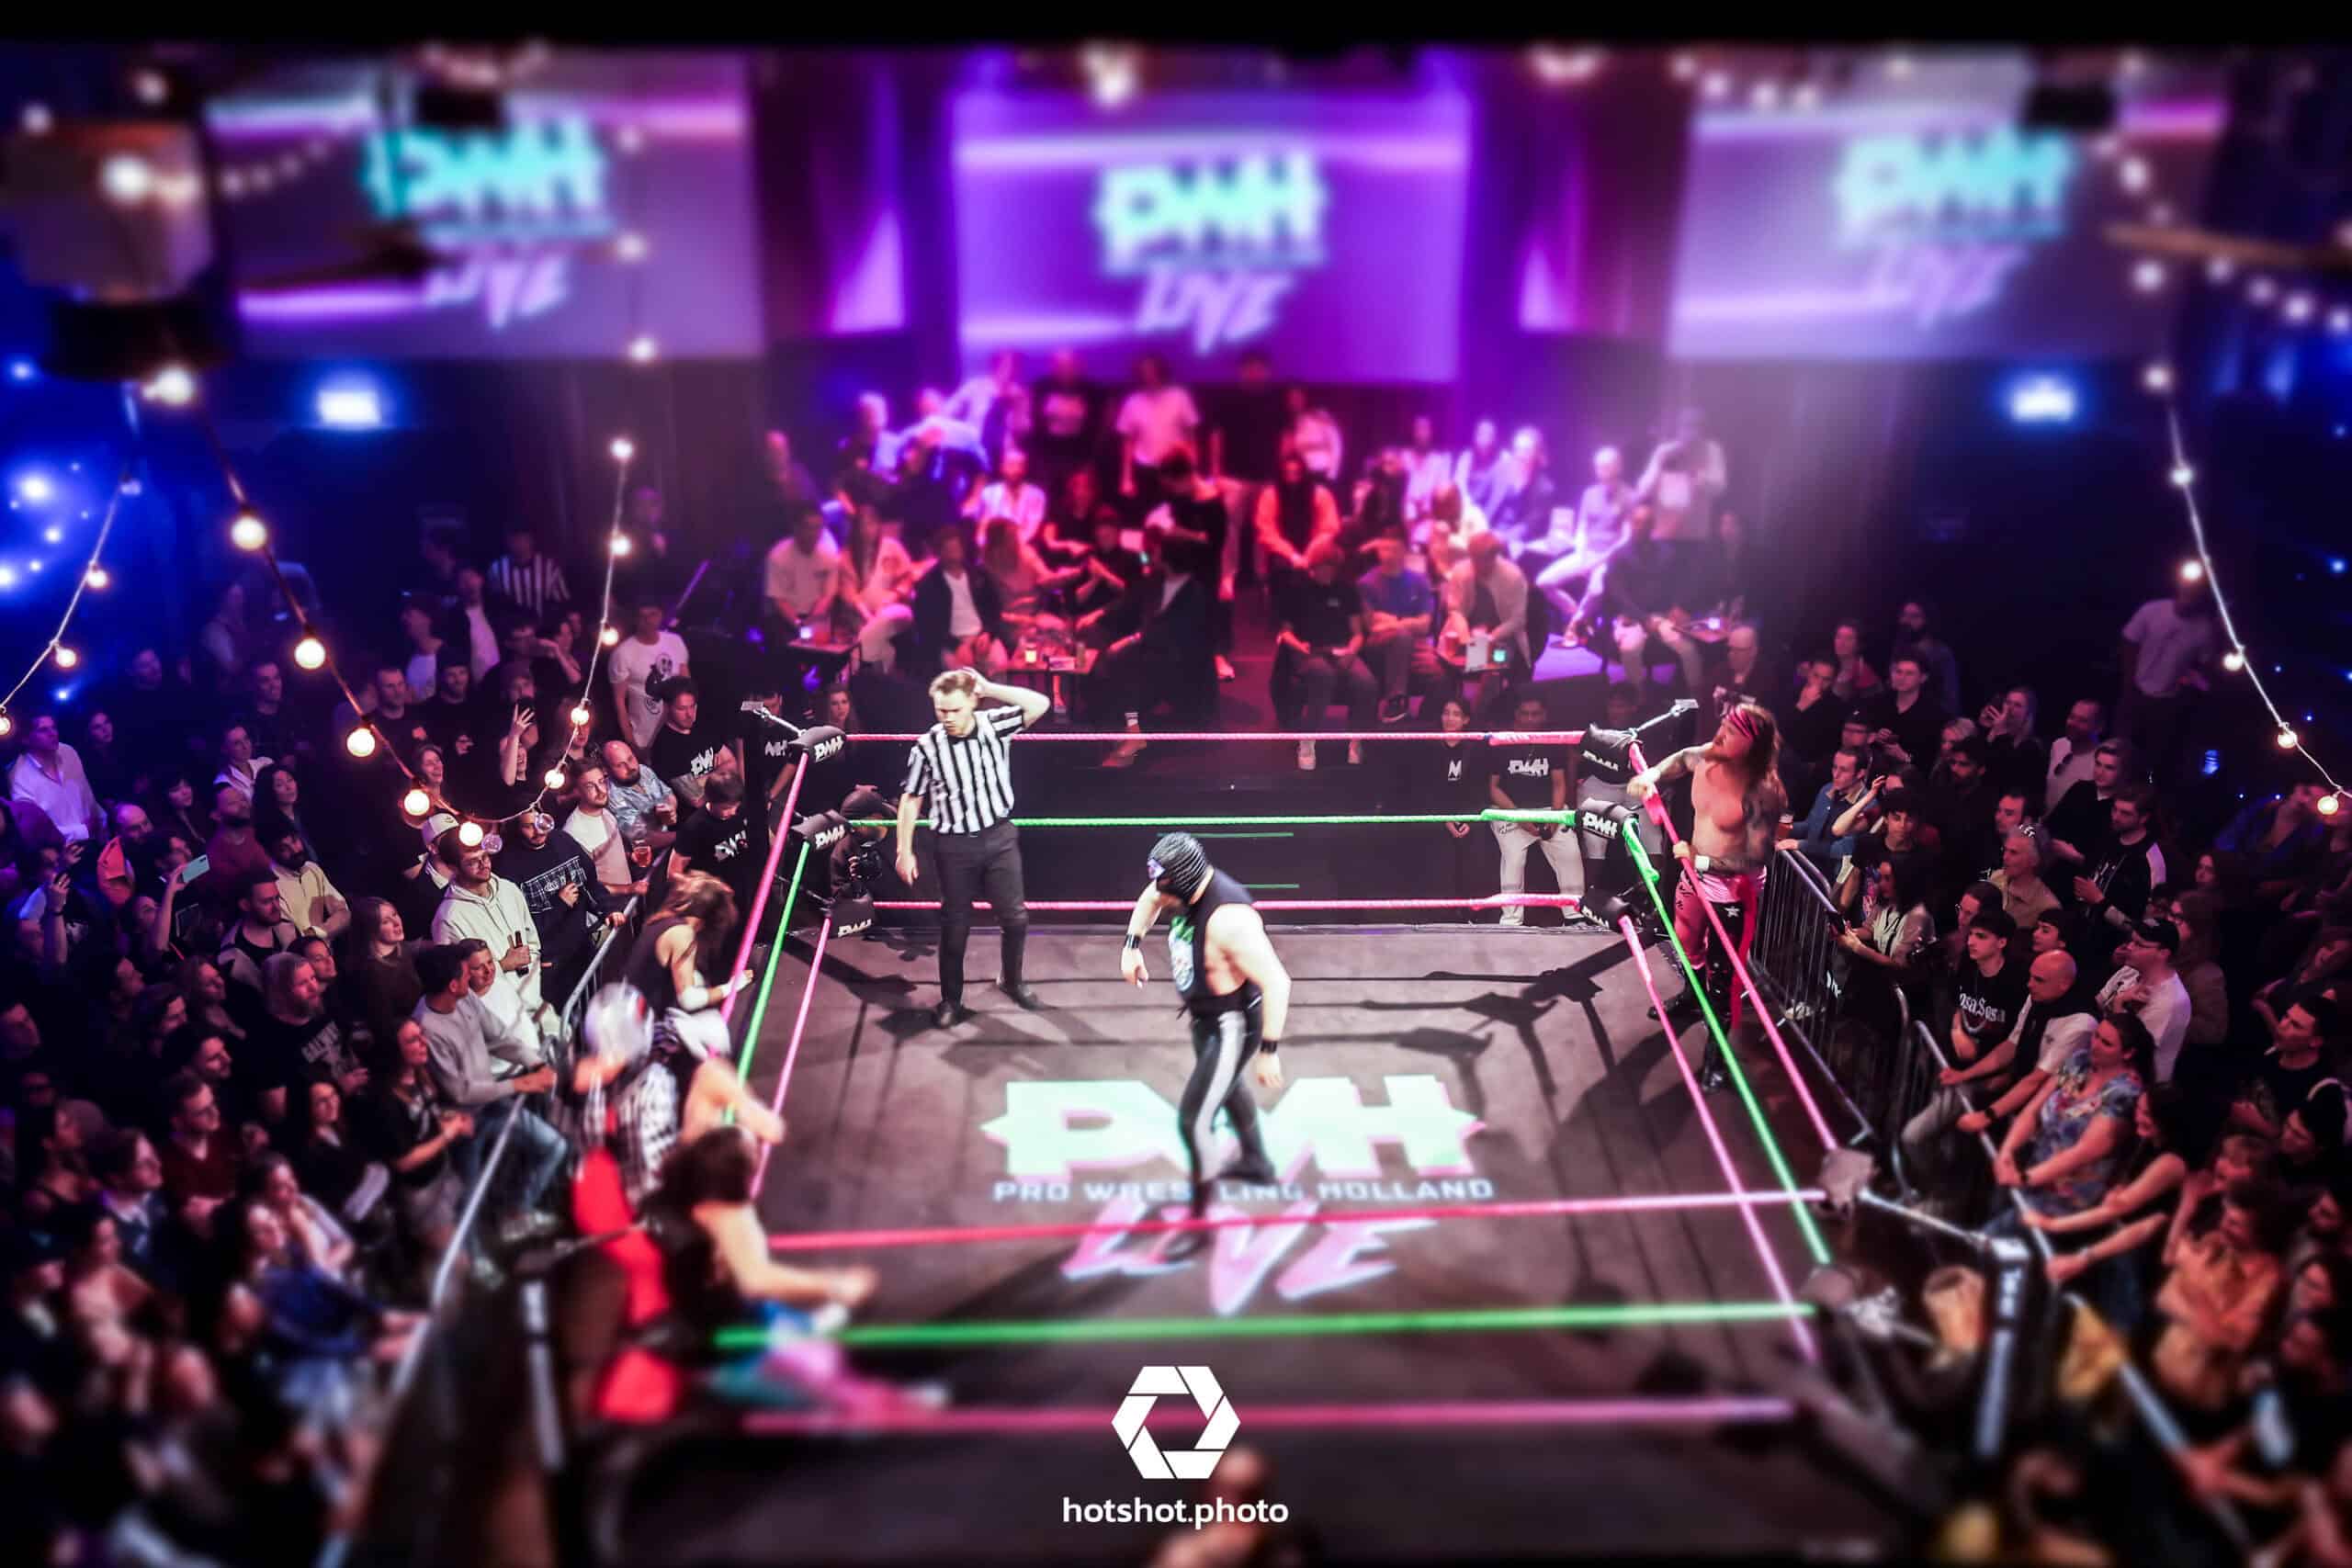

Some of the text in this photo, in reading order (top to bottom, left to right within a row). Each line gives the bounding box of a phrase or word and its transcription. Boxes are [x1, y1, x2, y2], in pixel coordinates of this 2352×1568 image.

[814, 736, 844, 762] PWH
[1508, 758, 1549, 777] PWH
[815, 825, 845, 850] PWH
[1582, 811, 1618, 839] PWH
[992, 1177, 1495, 1202] PRO WRESLING HOLLAND
